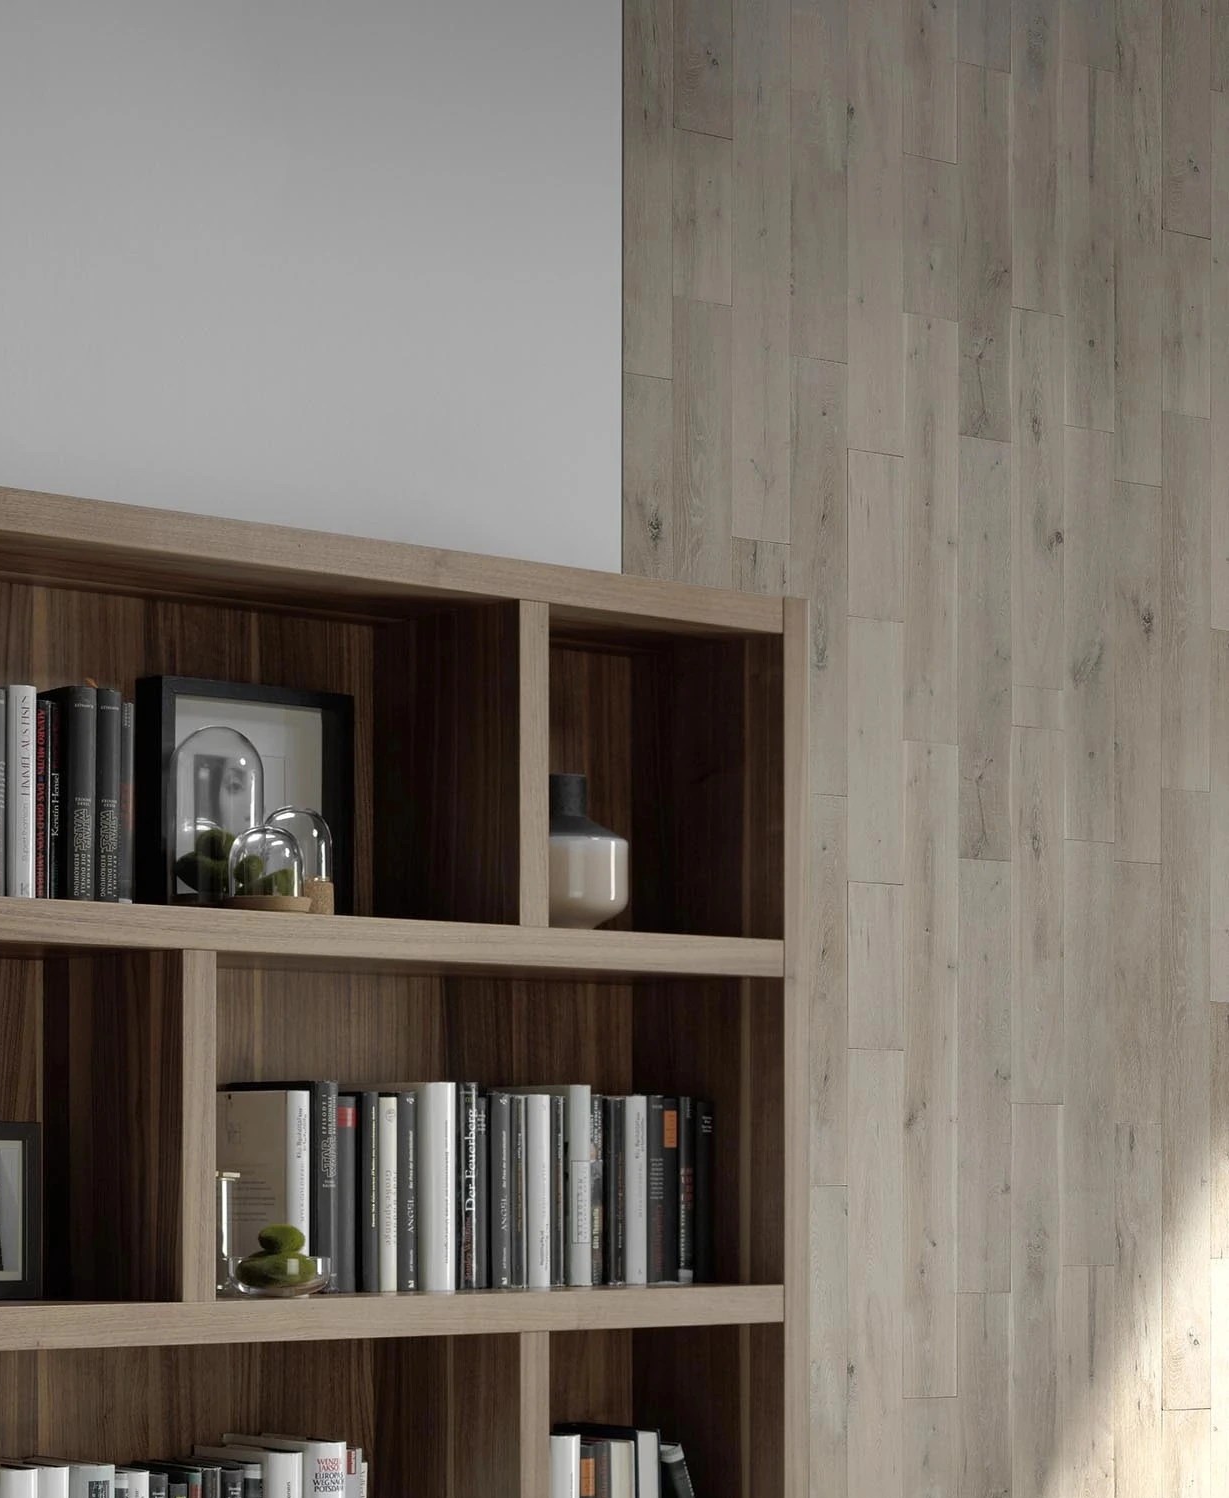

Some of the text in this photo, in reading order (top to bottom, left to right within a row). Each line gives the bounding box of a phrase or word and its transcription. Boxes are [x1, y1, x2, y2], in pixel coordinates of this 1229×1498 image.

[37, 709, 46, 744] ALVARO
[51, 772, 59, 837] Kerstin Hensel
[74, 808, 85, 852] WARS
[100, 810, 110, 854] WARS
[464, 1108, 478, 1211] Der Feuerberg
[500, 1194, 508, 1231] ANGEL
[314, 1485, 344, 1493] POTSDAM
